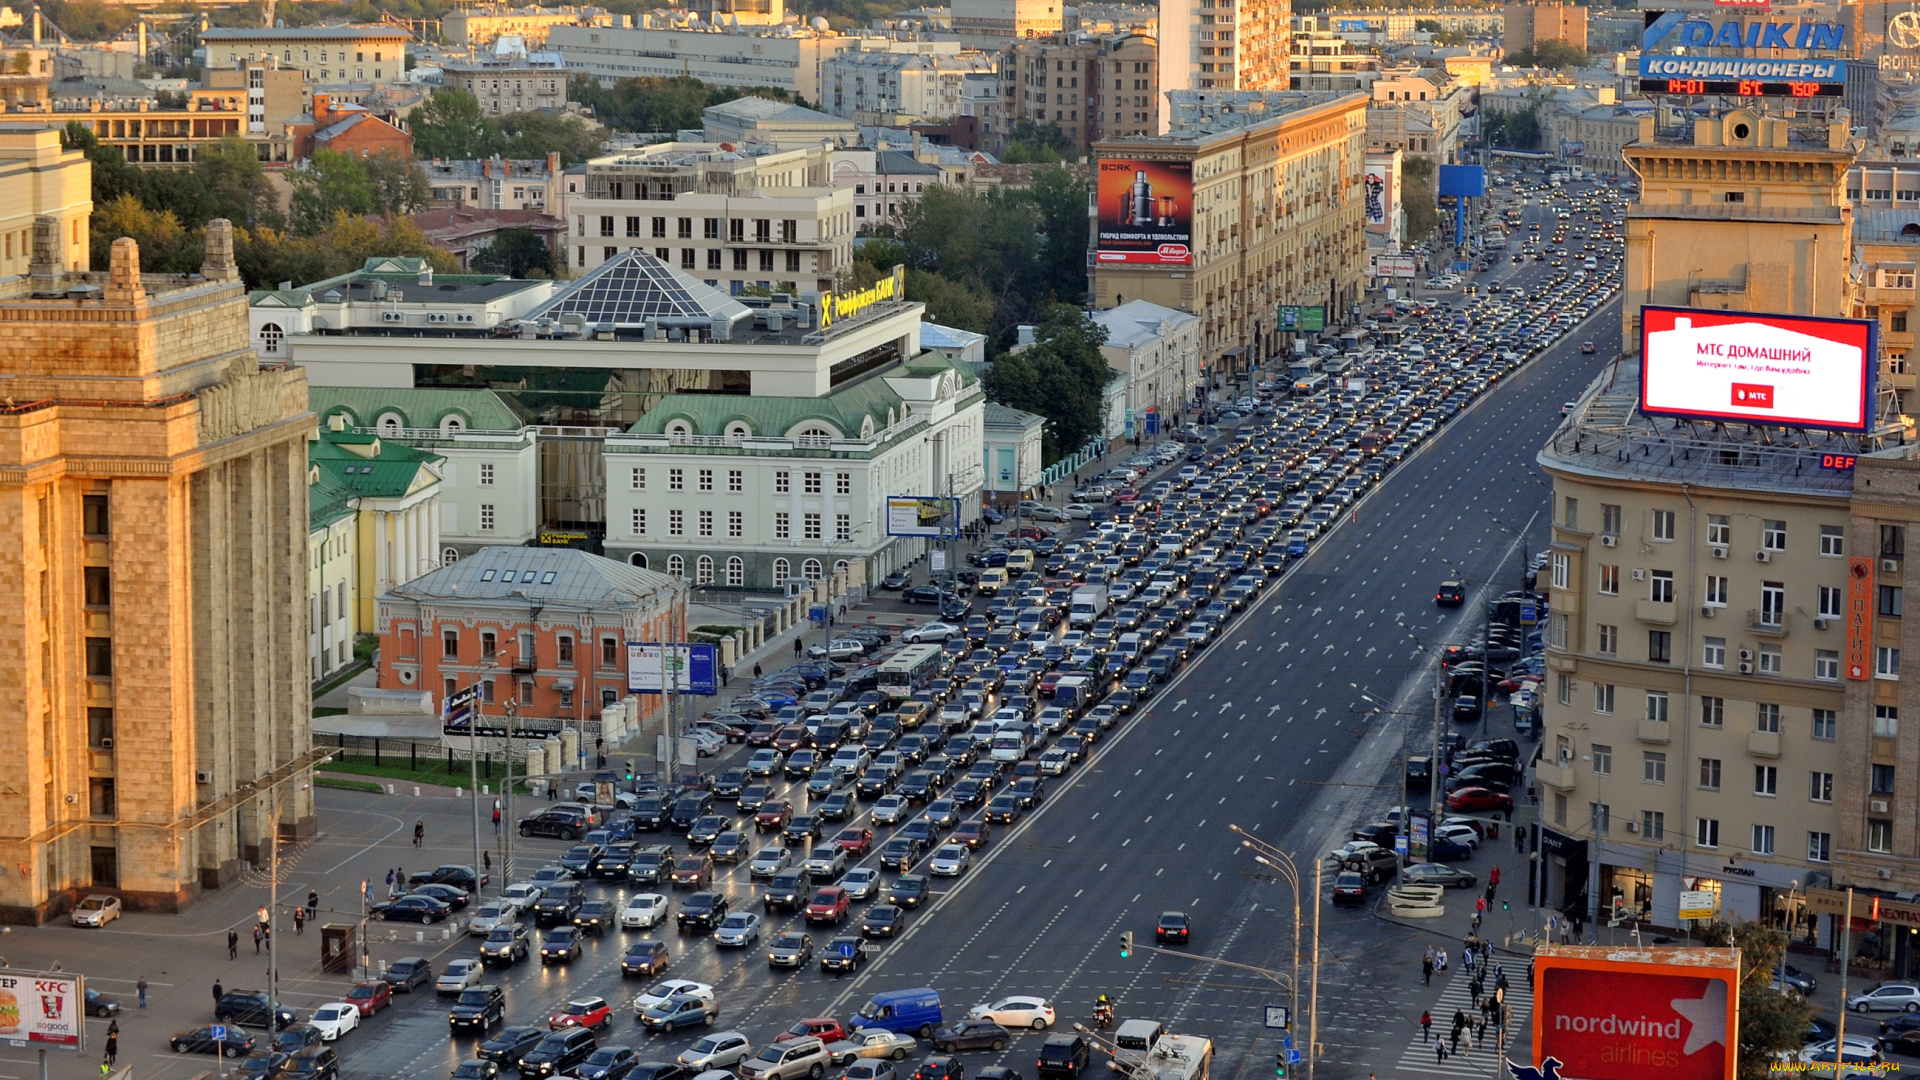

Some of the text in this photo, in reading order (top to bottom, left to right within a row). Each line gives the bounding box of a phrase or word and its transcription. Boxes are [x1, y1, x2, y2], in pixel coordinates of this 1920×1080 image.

[1679, 20, 1845, 50] DAIKIN
[1648, 59, 1837, 78] КОНДИЦИОНЕРЫ
[1668, 79, 1705, 94] 14-01
[1100, 232, 1119, 240] ГИБРИД
[1120, 232, 1147, 240] КОМФОРТА
[1152, 233, 1188, 241] УДОВОЛЬСТВИЯ
[836, 276, 894, 317] Райффайзен БАНК
[1697, 342, 1811, 363] МТС ДОМАШНИЙ
[1697, 360, 1731, 369] Интернет
[1748, 391, 1766, 400] МТС
[1823, 455, 1855, 469] DEF
[1851, 599, 1865, 664] ПАТИО
[1543, 836, 1562, 849] GANT
[1723, 866, 1755, 877] РУСЛАН
[0, 978, 17, 989] ЕР
[36, 980, 68, 993] KFC
[1555, 1013, 1681, 1040] nordwind
[1601, 1042, 1679, 1068] airlines
